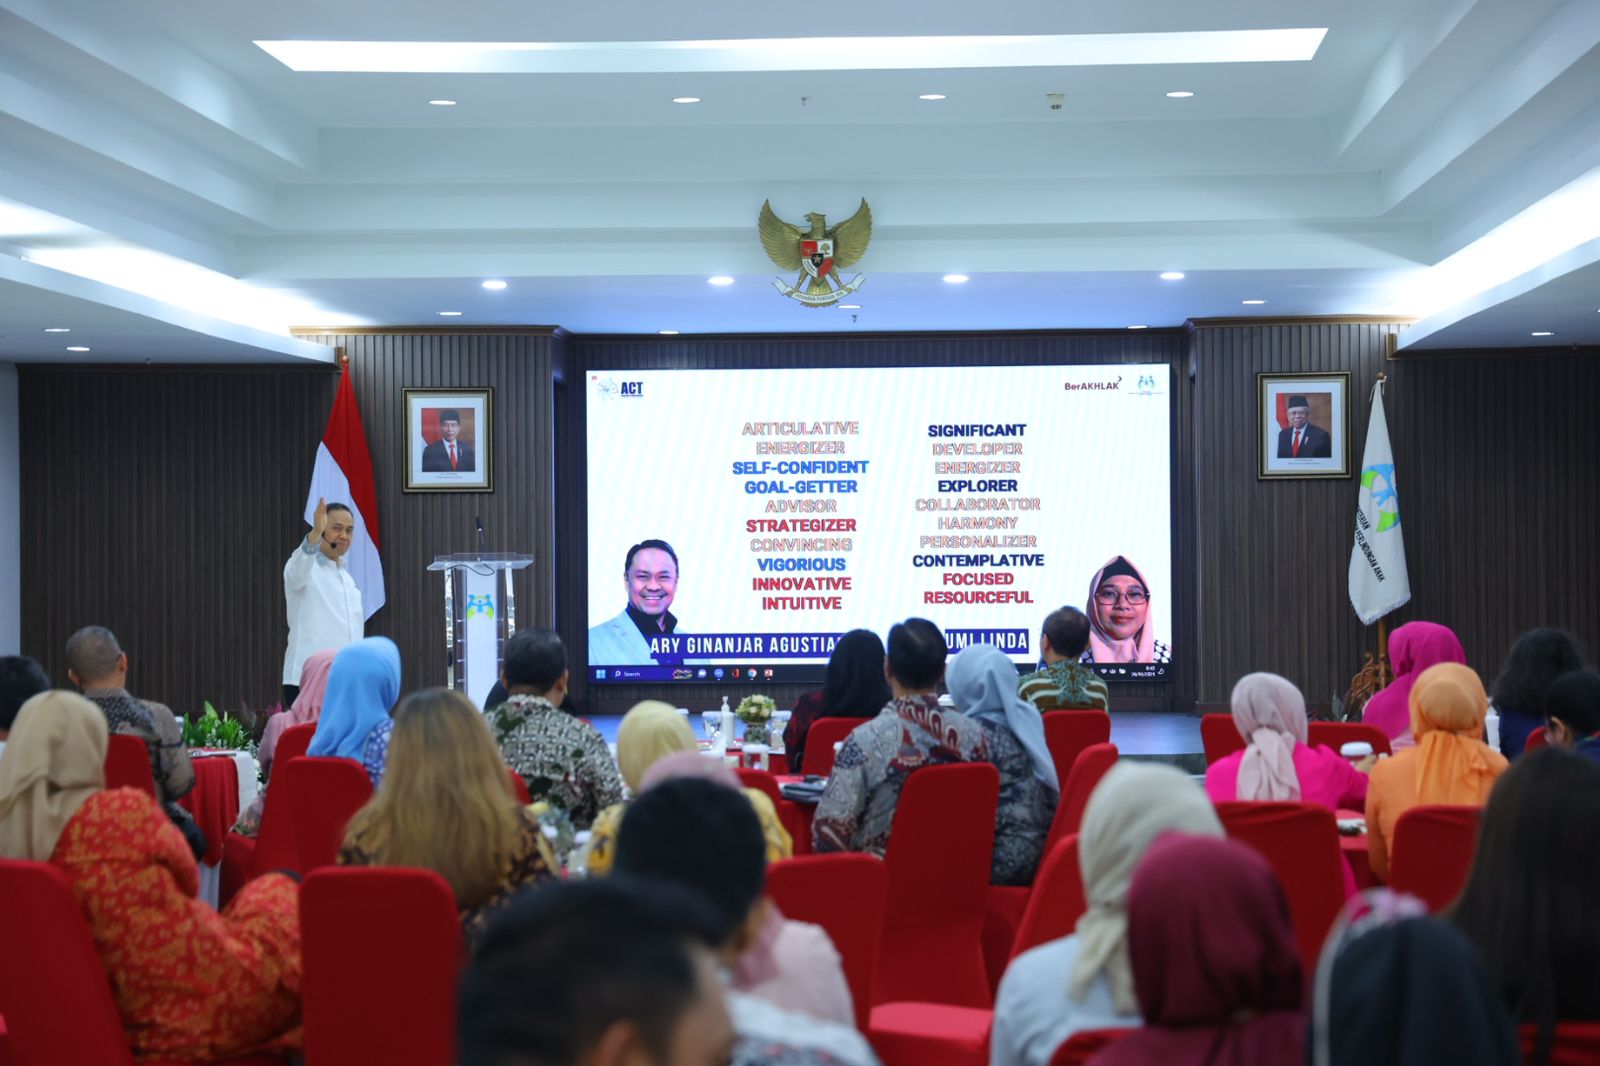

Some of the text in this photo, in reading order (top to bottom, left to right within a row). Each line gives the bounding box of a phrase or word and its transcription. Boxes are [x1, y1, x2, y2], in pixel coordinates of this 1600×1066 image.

[621, 382, 643, 395] ACT
[1065, 382, 1119, 391] BerAKHLAK
[742, 421, 859, 436] ARTICULATIVE
[927, 423, 1028, 438] SIGNIFICANT
[756, 441, 846, 455] ENERGIZER
[933, 443, 1023, 456] DEVELOPER
[732, 460, 870, 475] SELF-CONFIDENT
[935, 461, 1021, 474] ENERGIZER
[744, 479, 858, 495] GOAL-GETTER
[938, 479, 1018, 493] EXPLORER
[765, 499, 837, 513] ADVISOR
[915, 498, 1041, 511] COLLABORATOR
[746, 518, 857, 533] STRATEGIZER
[938, 516, 1019, 530] HARMONY
[751, 537, 853, 552] CONVINCING
[920, 535, 1037, 548] PERSONALIZER
[757, 557, 847, 572] VIGORIOUS
[912, 554, 1045, 568] CONTEMPLATIVE
[752, 577, 852, 591] INNOVATIVE
[943, 572, 1015, 586] FOCUSED
[762, 596, 842, 611] INTUITIVE
[924, 591, 1034, 605] RESOURCEFUL
[650, 635, 841, 654] ARY GINANJAR AGUSTIA
